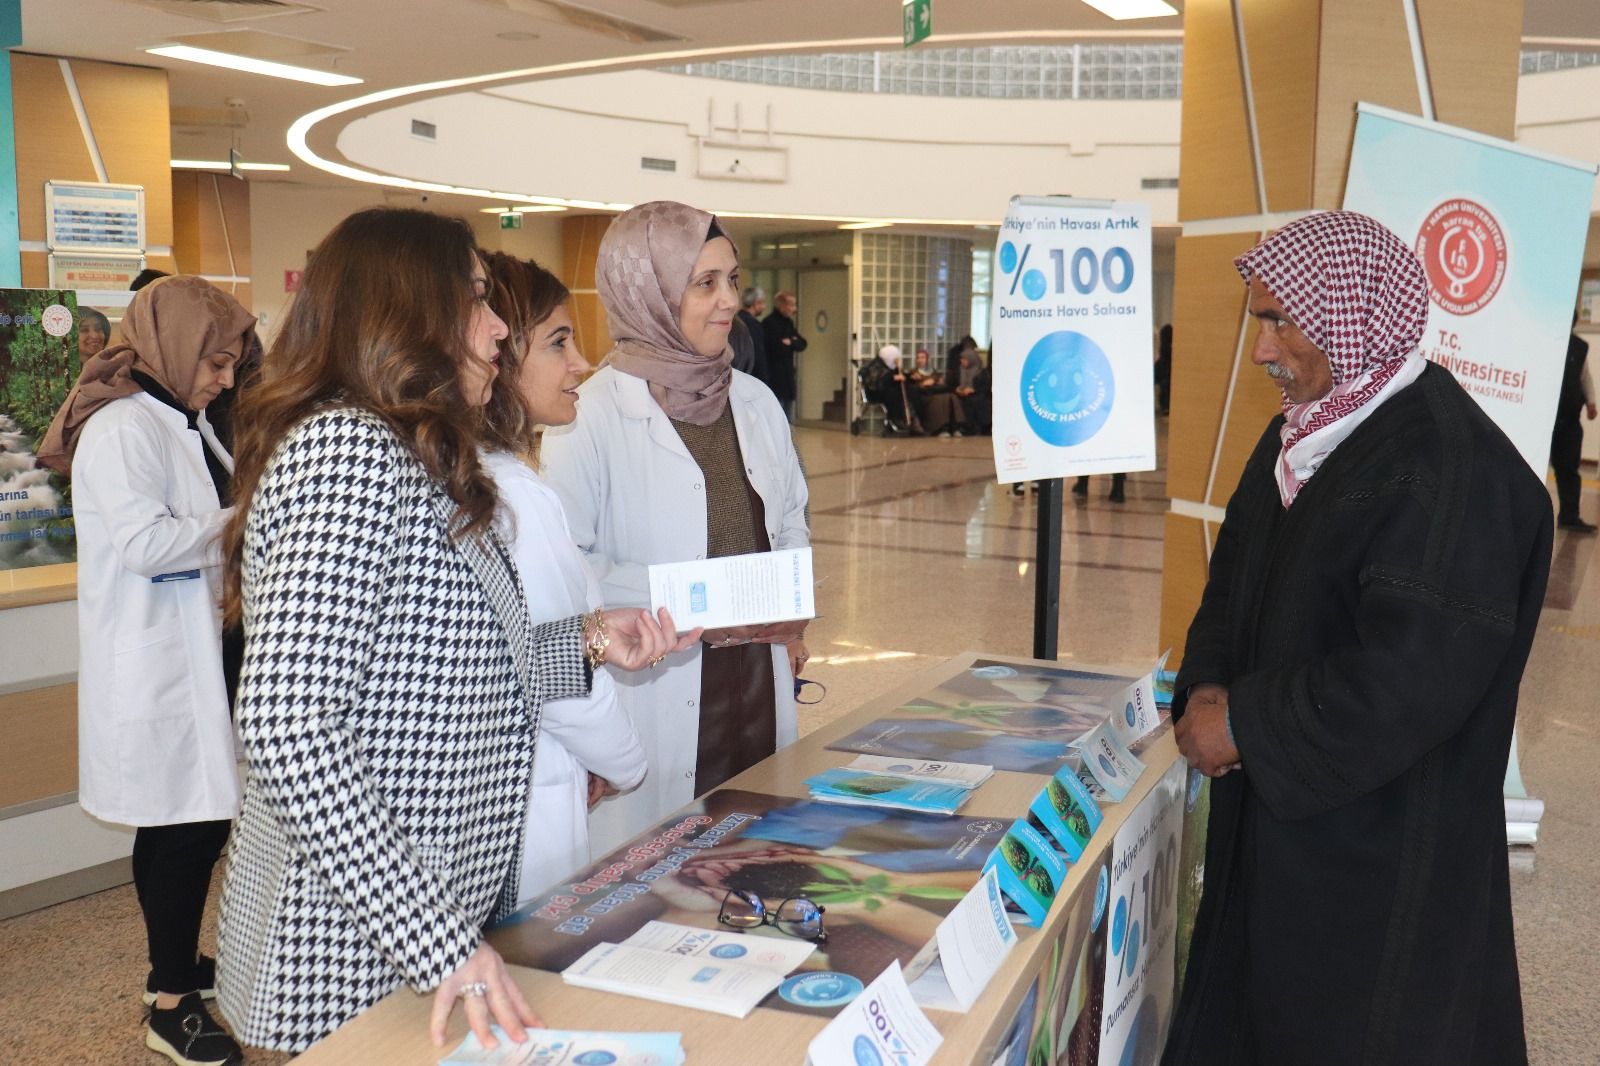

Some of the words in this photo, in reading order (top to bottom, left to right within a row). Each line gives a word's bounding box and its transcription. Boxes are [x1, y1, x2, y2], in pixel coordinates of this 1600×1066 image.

[1060, 217, 1101, 230] Havası
[1105, 216, 1139, 230] Artık
[1000, 240, 1134, 302] %100
[1000, 306, 1053, 319] Dumansız
[1056, 306, 1089, 317] Hava
[1093, 303, 1136, 317] Sahası
[1438, 330, 1462, 351] T.C.
[1431, 347, 1527, 389] ÜNİVERSİTESİ
[1473, 384, 1524, 404] HASTANESİ
[571, 861, 634, 895] sahip
[636, 846, 700, 882] yerine
[584, 881, 650, 916] fidan
